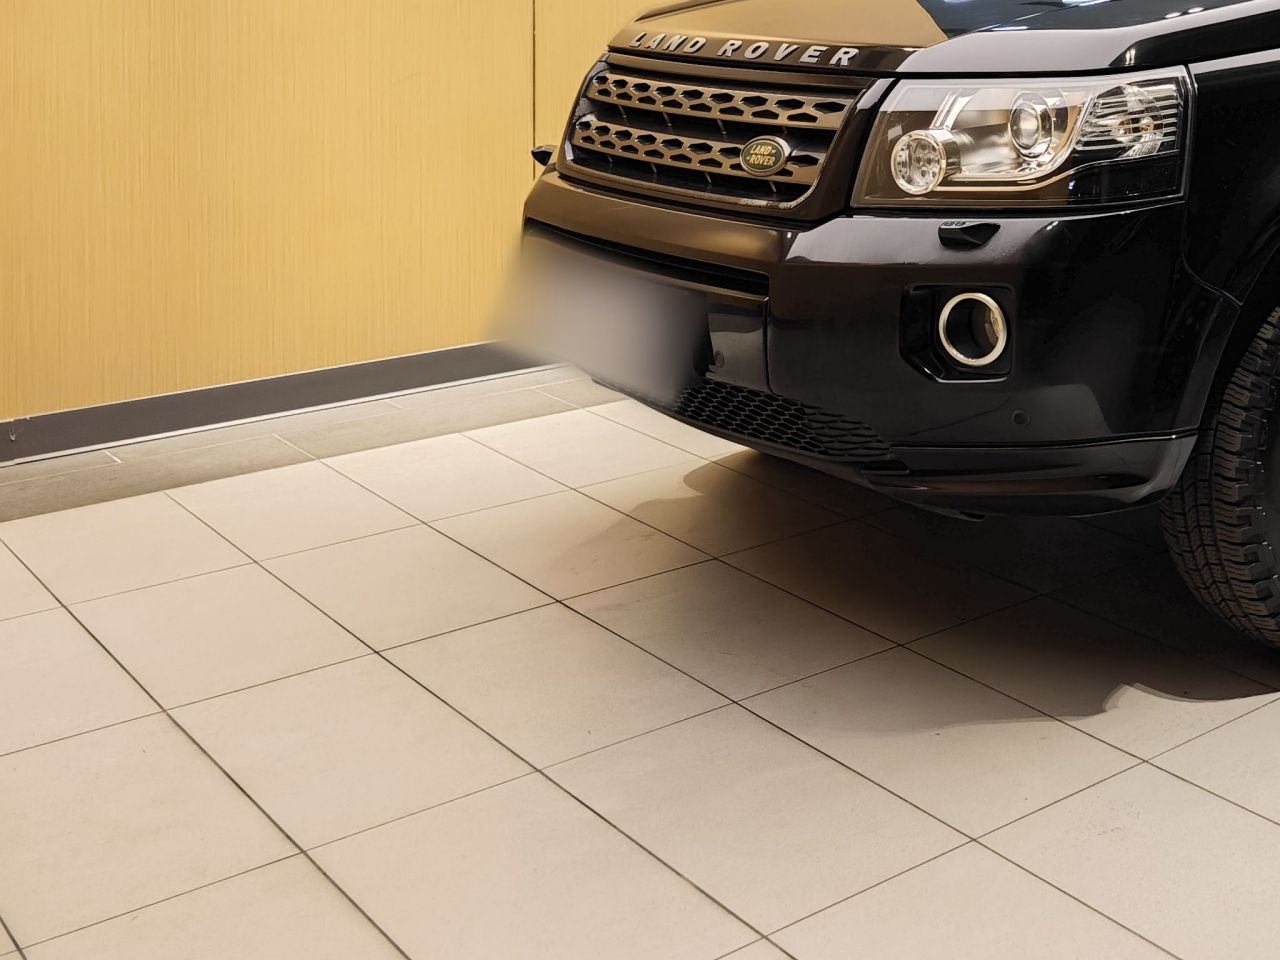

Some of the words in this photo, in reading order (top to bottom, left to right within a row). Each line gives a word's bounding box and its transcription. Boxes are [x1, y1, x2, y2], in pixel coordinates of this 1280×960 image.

[629, 32, 707, 54] LAND
[716, 39, 860, 66] ROVER
[749, 144, 772, 155] LAND
[749, 154, 776, 166] ROVER
